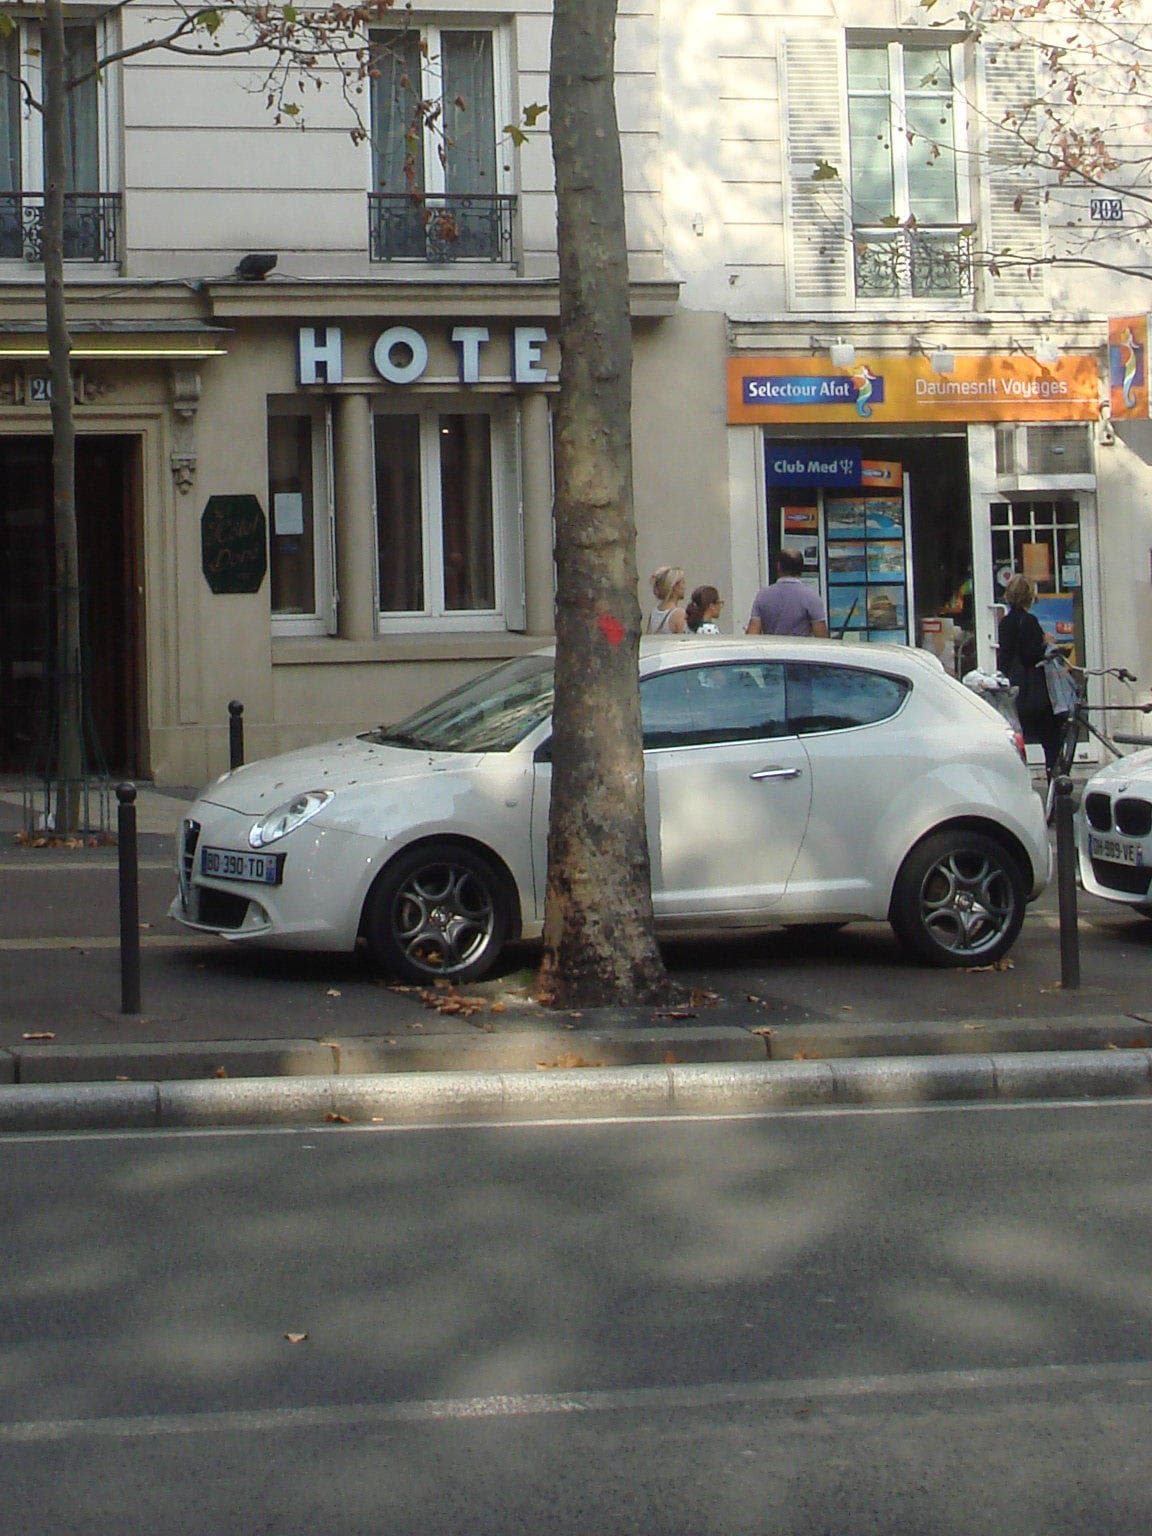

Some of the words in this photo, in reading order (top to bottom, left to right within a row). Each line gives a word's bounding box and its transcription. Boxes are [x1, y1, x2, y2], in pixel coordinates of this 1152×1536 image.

[1091, 200, 1122, 220] 203
[299, 326, 546, 384] HOTE
[749, 382, 817, 397] Selectour
[820, 381, 850, 396] Afat
[915, 378, 997, 395] Daumesnil
[1001, 379, 1068, 398] Voyages
[774, 460, 805, 473] Club
[807, 460, 838, 474] Med
